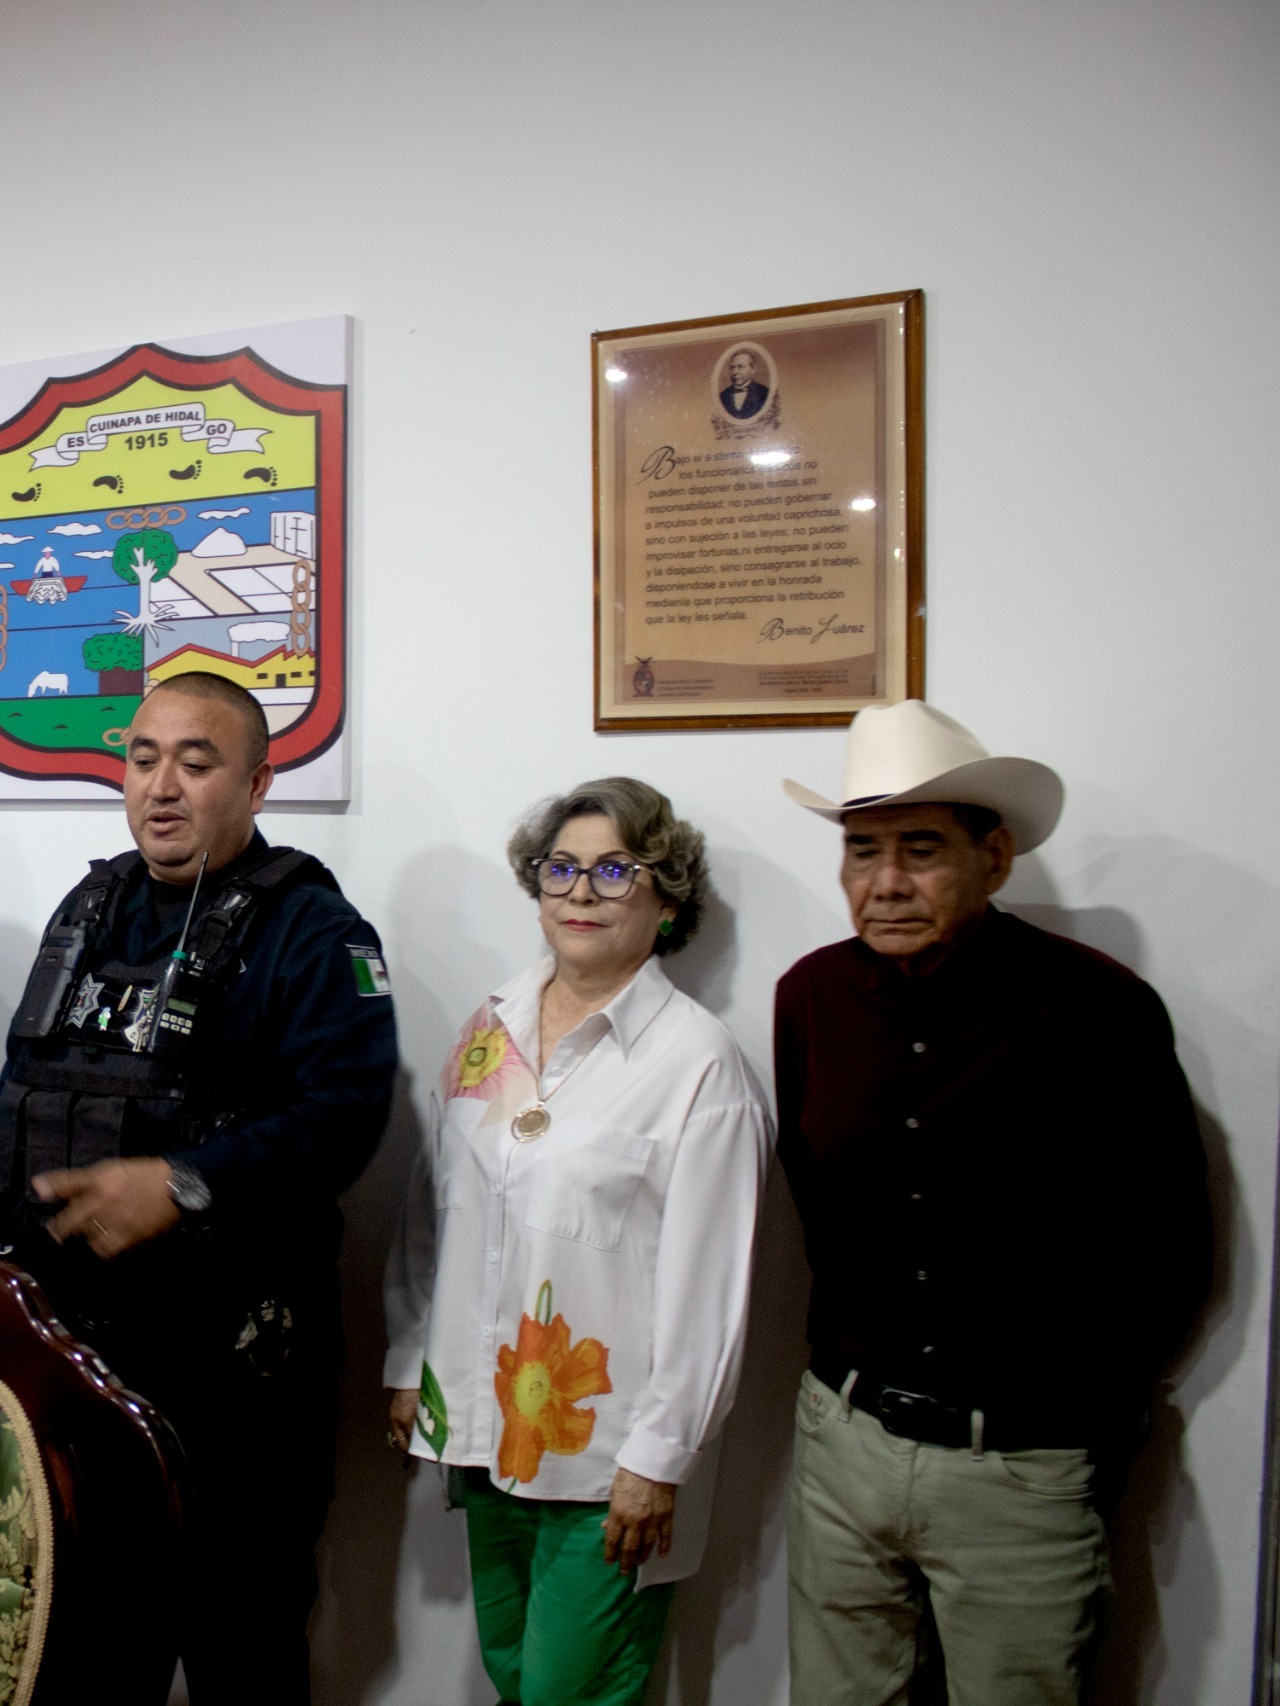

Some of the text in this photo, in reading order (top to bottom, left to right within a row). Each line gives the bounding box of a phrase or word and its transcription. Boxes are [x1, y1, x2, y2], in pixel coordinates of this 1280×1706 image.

[67, 411, 227, 448] ES CUINAPA DE HIDAL GO
[125, 433, 168, 450] 1915
[679, 471, 693, 479] los
[649, 489, 685, 498] pueden
[688, 485, 730, 496] disponer
[733, 482, 746, 491] de
[749, 482, 763, 490] las
[744, 497, 781, 507] pueden
[785, 493, 832, 505] gobernar
[655, 519, 697, 529] impulsos
[701, 517, 713, 525] de
[716, 516, 735, 524] una
[738, 513, 781, 522] voluntad
[646, 537, 665, 545] sino
[689, 532, 730, 543] sujeción
[809, 525, 848, 536] pueden
[646, 550, 696, 561] improvisar
[754, 544, 809, 554] entregarse
[812, 542, 821, 550] al
[824, 541, 846, 549] ocio
[654, 568, 663, 576] la
[721, 564, 741, 572] sino
[744, 560, 807, 571] consagrarse
[810, 558, 819, 567] al
[767, 577, 776, 585] la
[779, 575, 821, 584] honrada
[693, 598, 712, 607] que
[715, 595, 774, 606] proporciona
[777, 593, 786, 601] la
[790, 590, 844, 600] retribución
[645, 617, 663, 625] que
[666, 614, 675, 622] la
[678, 614, 692, 624] ley
[695, 613, 709, 621] les
